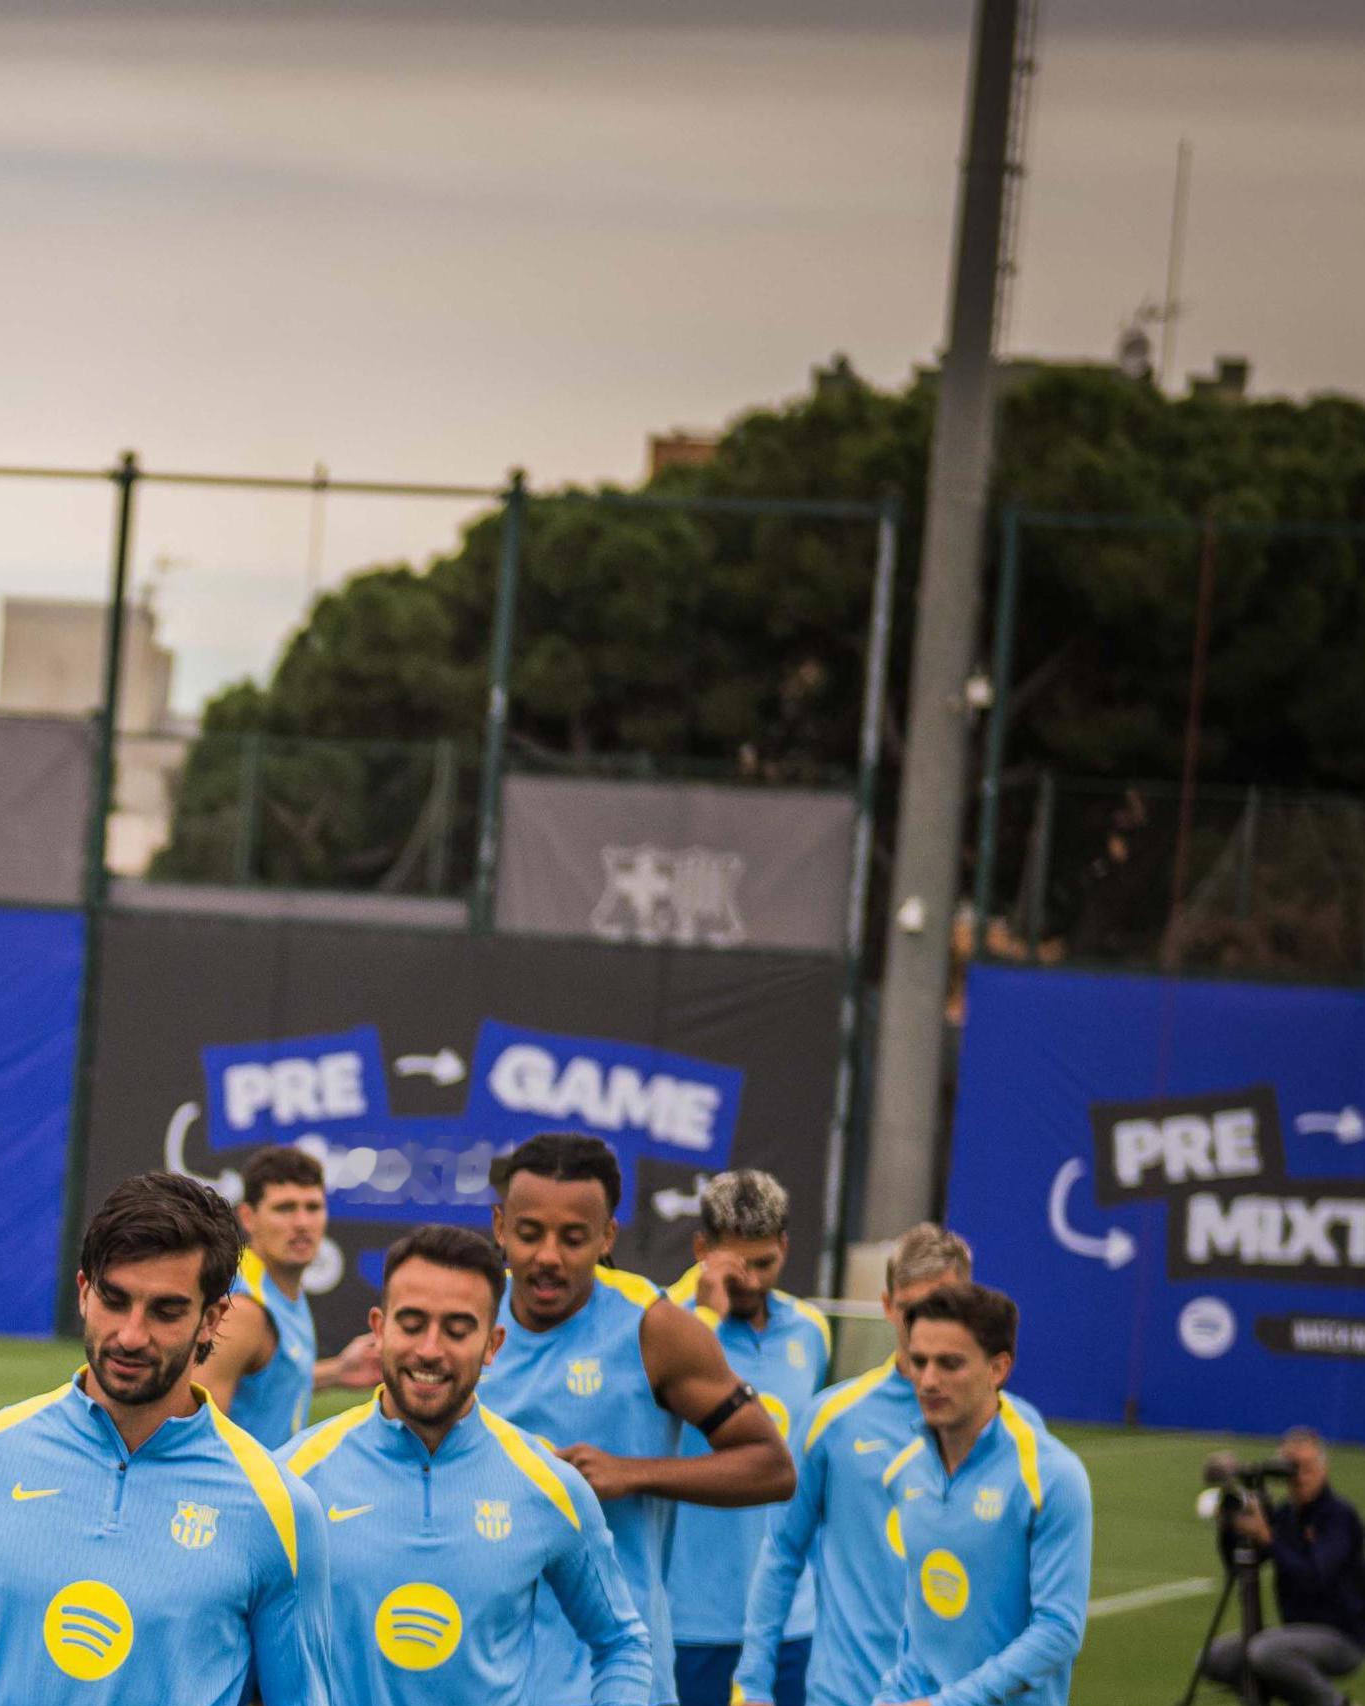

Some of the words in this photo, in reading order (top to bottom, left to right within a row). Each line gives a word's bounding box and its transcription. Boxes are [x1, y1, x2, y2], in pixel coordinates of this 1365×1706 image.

[223, 1052, 365, 1129] PRE
[489, 1045, 722, 1150] GAME
[1113, 1109, 1260, 1187] PRE
